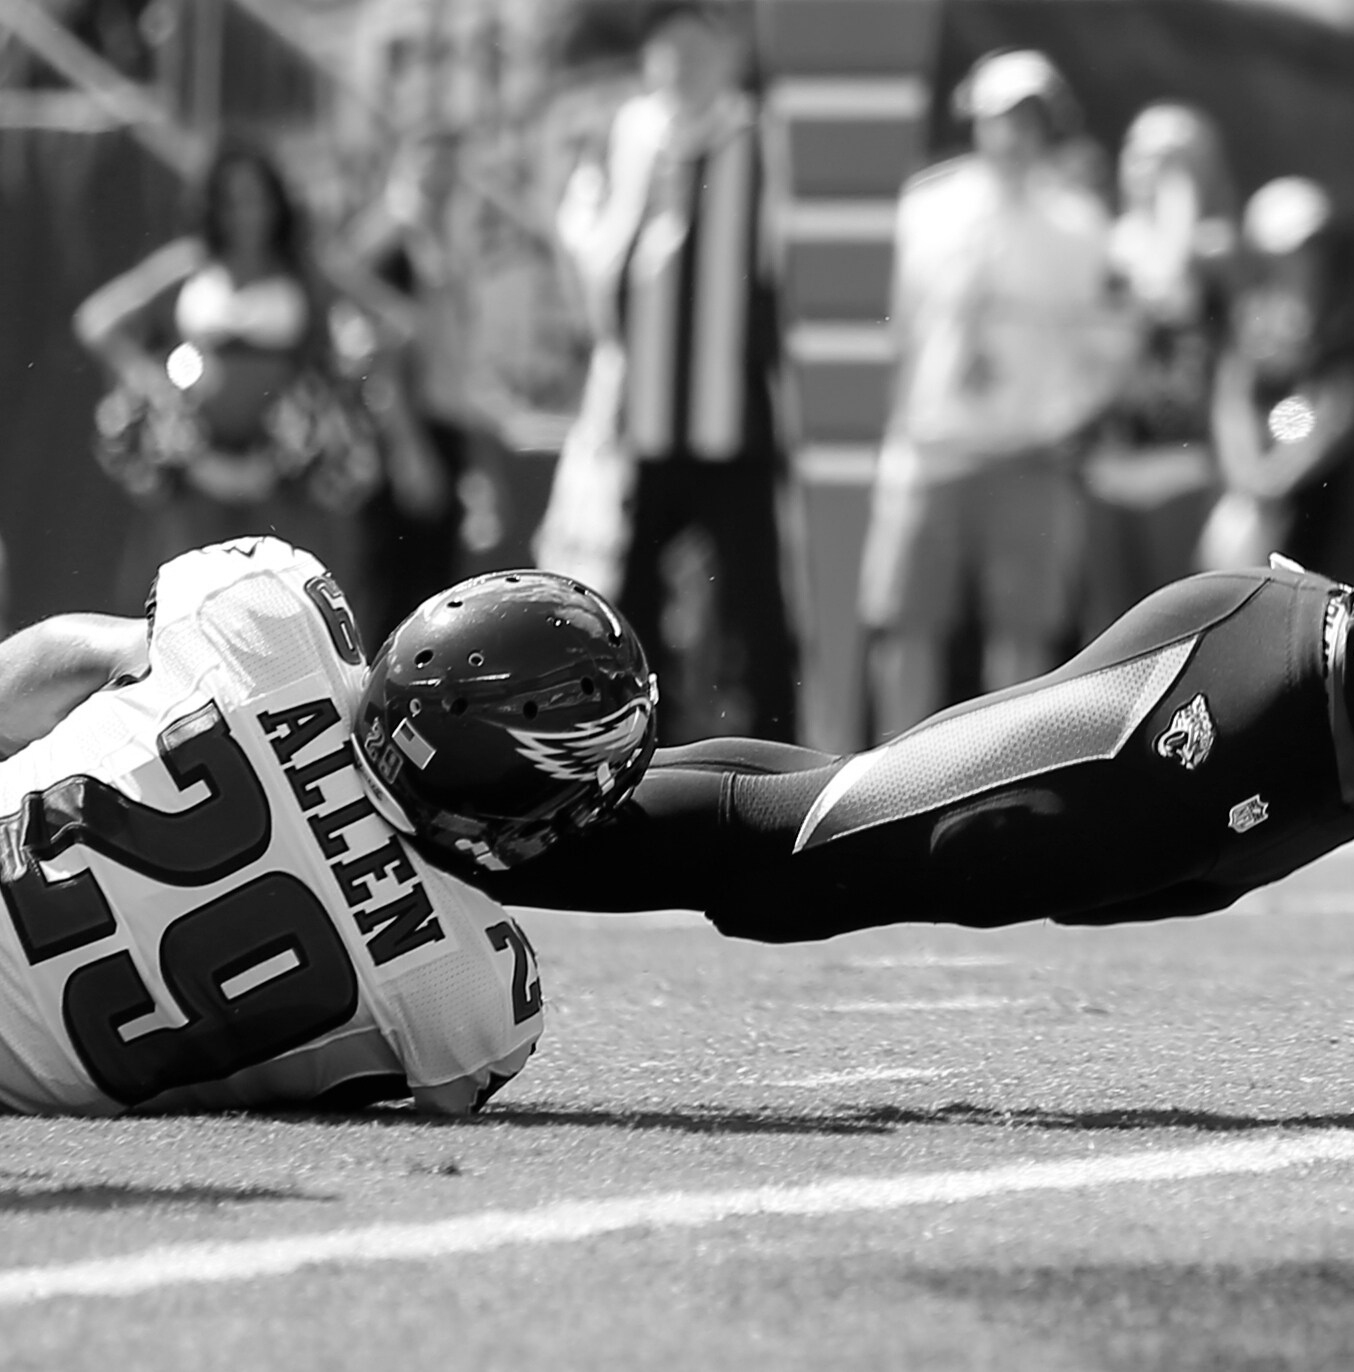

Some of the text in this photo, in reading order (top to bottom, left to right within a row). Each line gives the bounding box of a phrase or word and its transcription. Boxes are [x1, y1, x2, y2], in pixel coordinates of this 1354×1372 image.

[257, 697, 446, 967] ALLEN
[364, 716, 404, 785] 29
[0, 698, 359, 1107] 29
[484, 917, 543, 1025] 2
